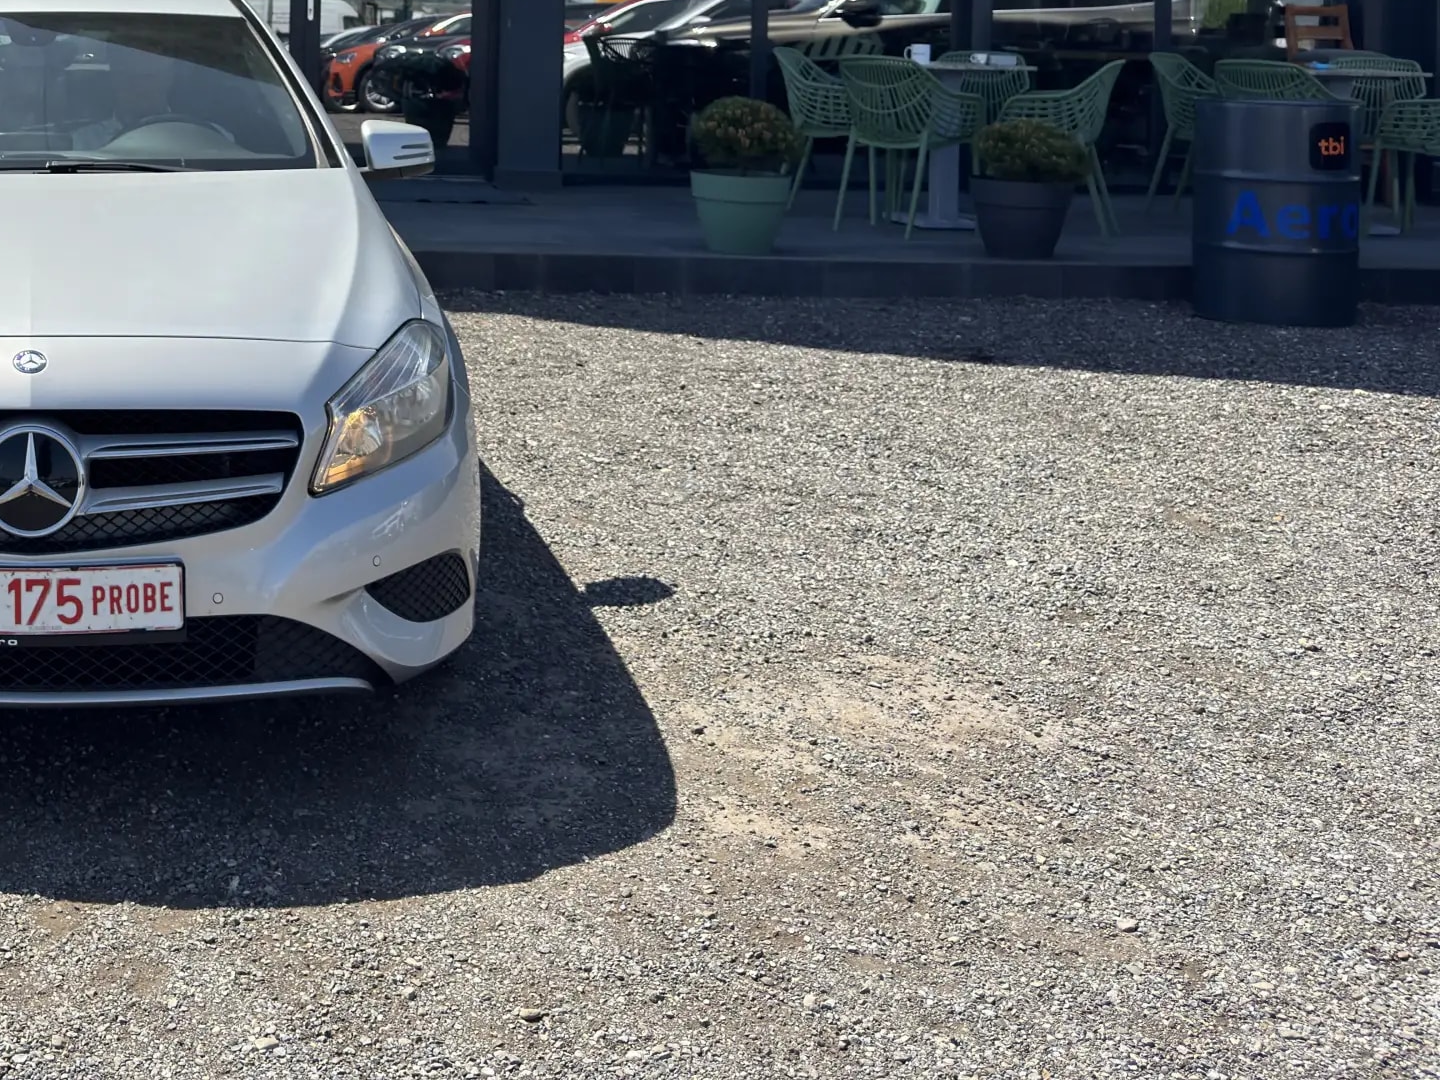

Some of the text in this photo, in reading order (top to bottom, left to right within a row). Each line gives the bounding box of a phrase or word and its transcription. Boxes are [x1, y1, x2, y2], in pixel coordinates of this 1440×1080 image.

[1317, 136, 1345, 156] tbi
[7, 577, 84, 626] 175
[92, 582, 173, 615] PROBE
